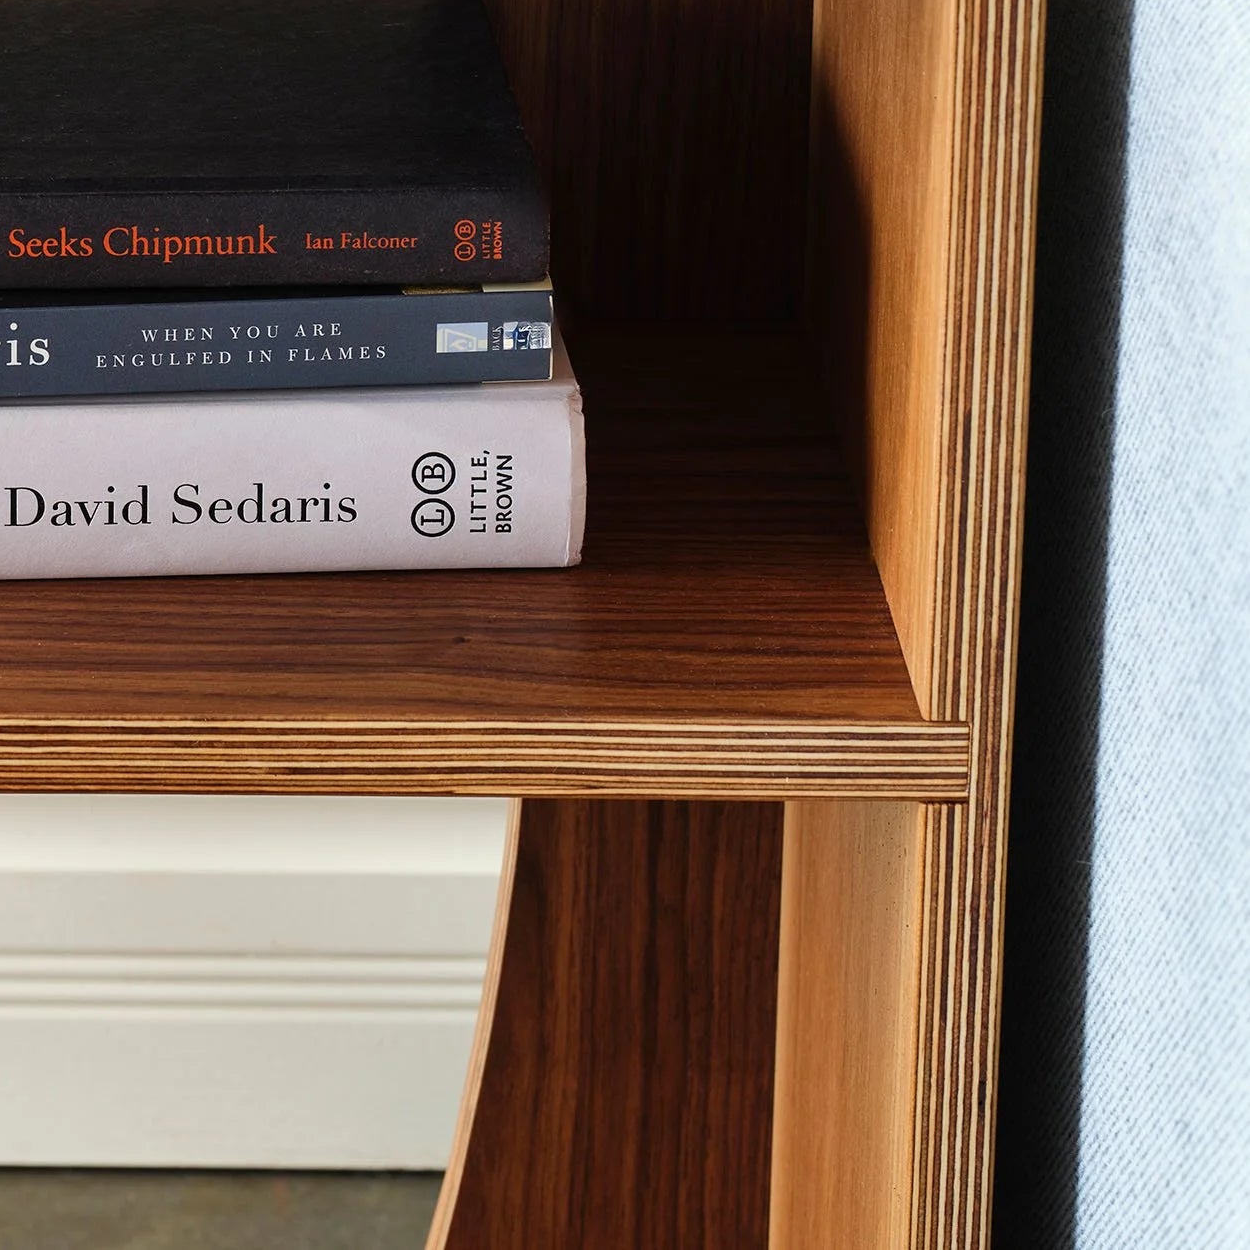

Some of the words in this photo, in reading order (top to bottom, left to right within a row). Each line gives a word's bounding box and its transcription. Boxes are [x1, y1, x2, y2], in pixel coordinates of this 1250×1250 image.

[7, 225, 94, 258] Seeks
[102, 223, 276, 263] Chipmunk
[305, 232, 334, 250] Ian
[340, 231, 418, 250] Falconer
[493, 221, 503, 260] BROWN
[141, 327, 214, 343] WHEN
[229, 325, 279, 339] YOU
[295, 322, 342, 337] ARE
[96, 351, 232, 368] ENGULFED
[247, 349, 272, 363] IN
[288, 345, 386, 361] FLAMES
[3, 484, 152, 527] David
[171, 482, 358, 525] Sedaris
[469, 450, 490, 533] LITTLE,
[494, 455, 513, 533] BROWN
